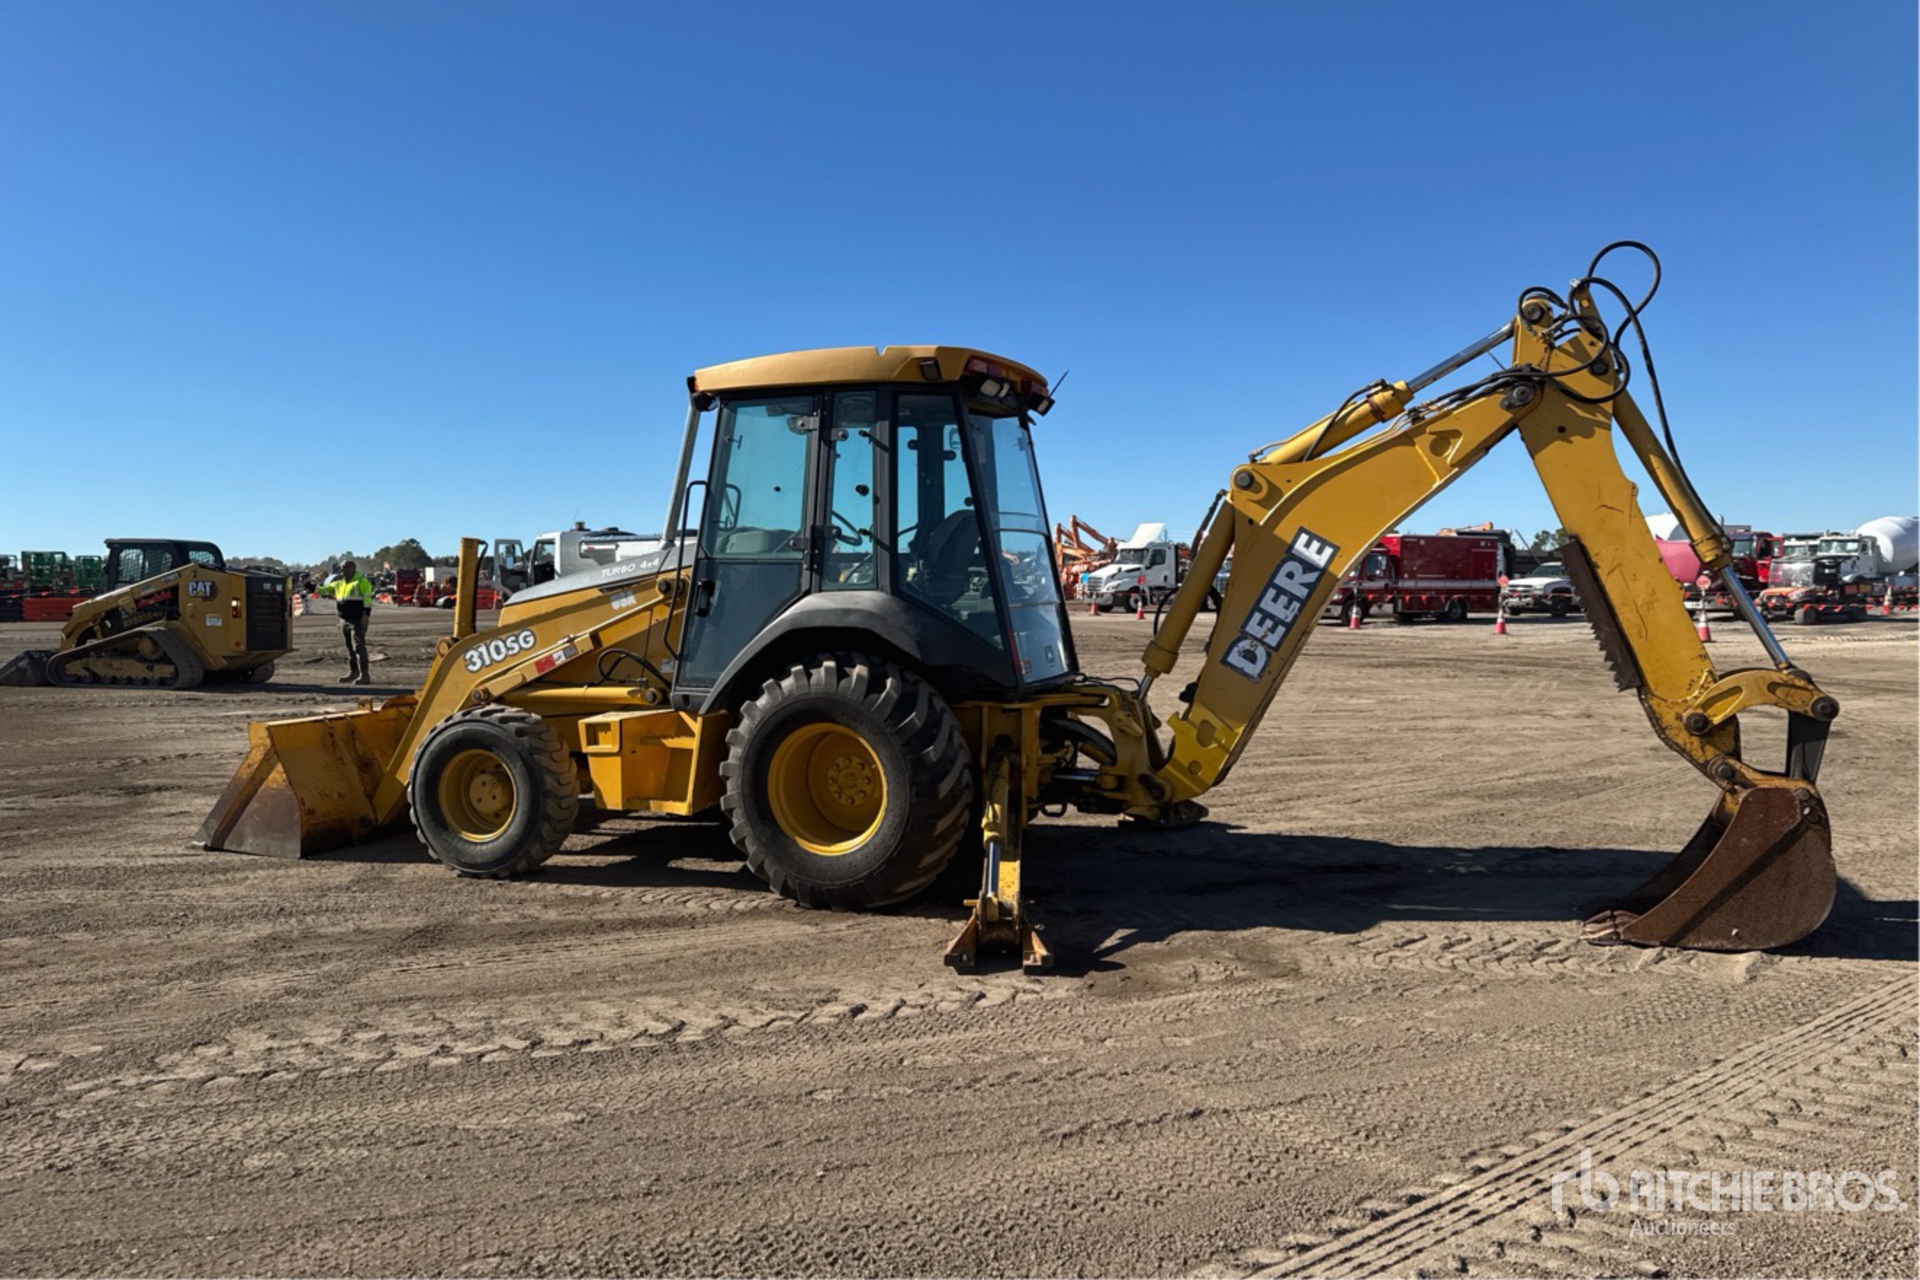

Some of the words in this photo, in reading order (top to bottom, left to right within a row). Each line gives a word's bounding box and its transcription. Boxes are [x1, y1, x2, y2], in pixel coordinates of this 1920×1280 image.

[601, 563, 637, 578] TURBO
[188, 581, 213, 598] CAT
[1225, 531, 1336, 679] DEERE
[464, 629, 536, 673] 310SG
